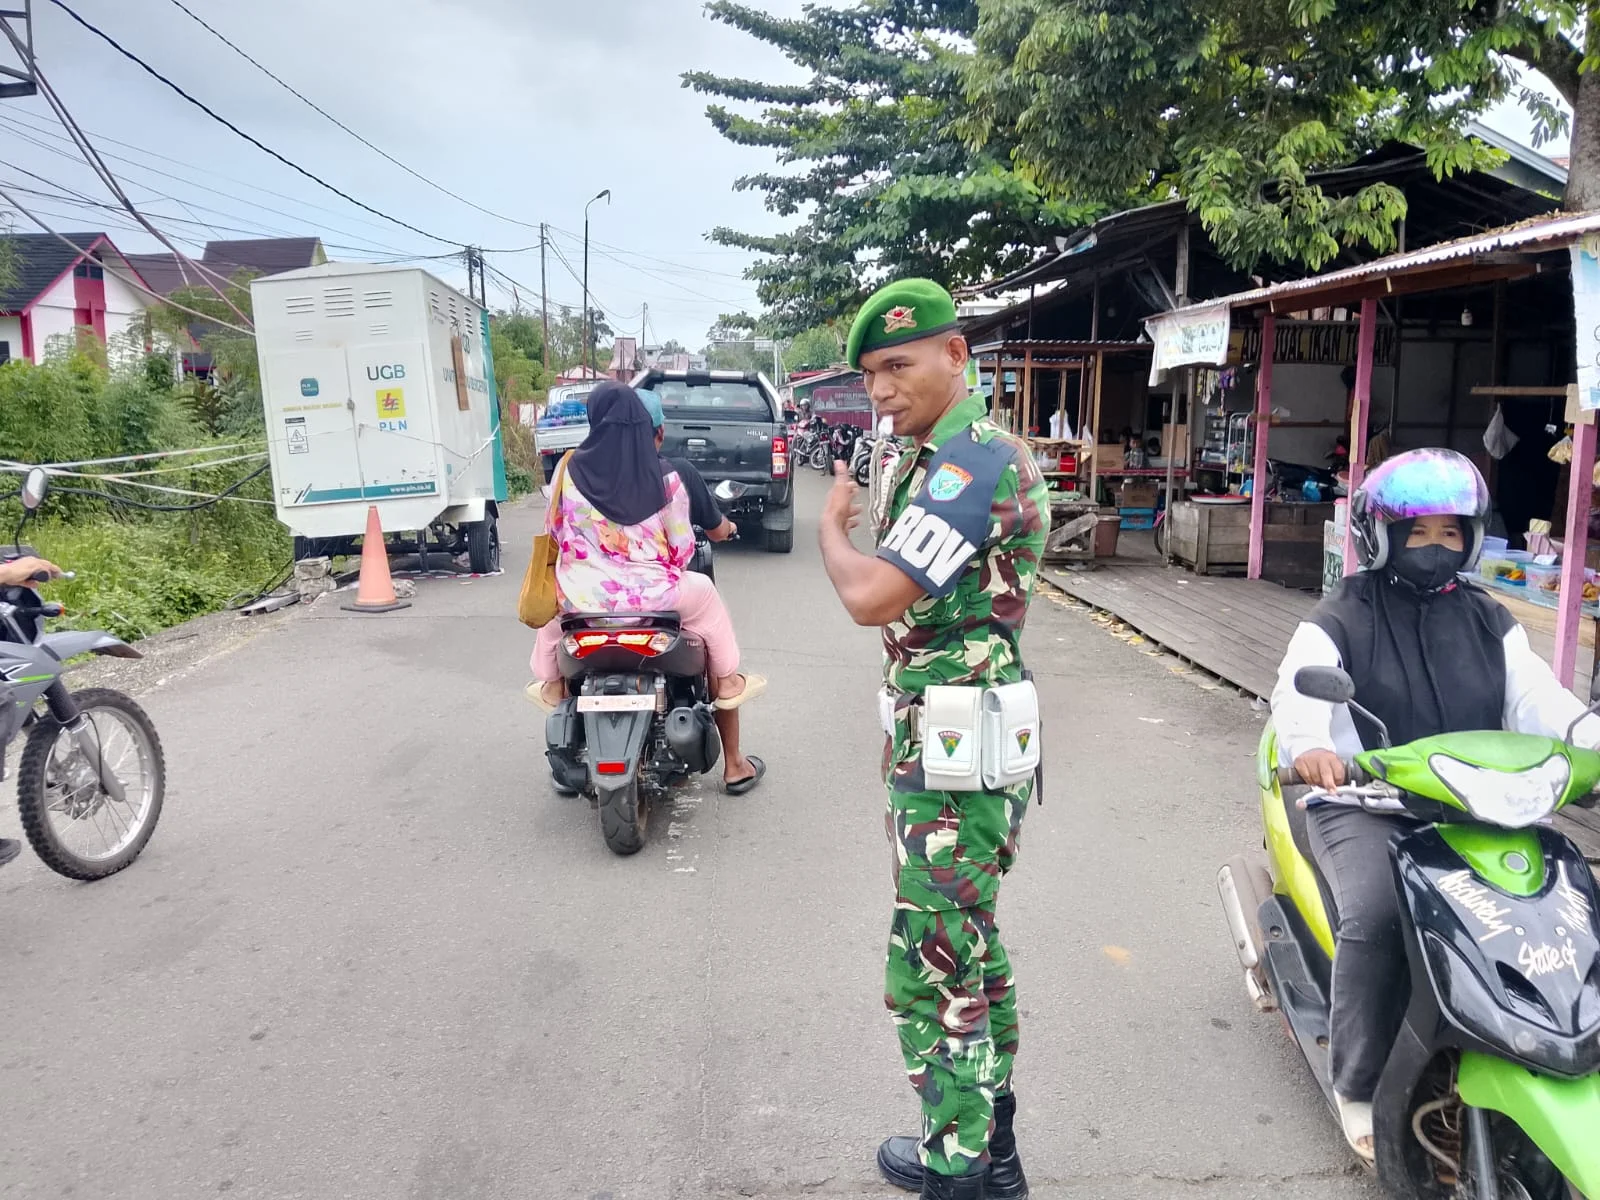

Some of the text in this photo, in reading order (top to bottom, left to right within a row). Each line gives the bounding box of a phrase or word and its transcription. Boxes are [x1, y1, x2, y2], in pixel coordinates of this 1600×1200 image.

[1308, 325, 1341, 361] IKAN
[367, 364, 405, 381] UGB
[379, 420, 408, 431] PLN
[1517, 941, 1564, 979] State
